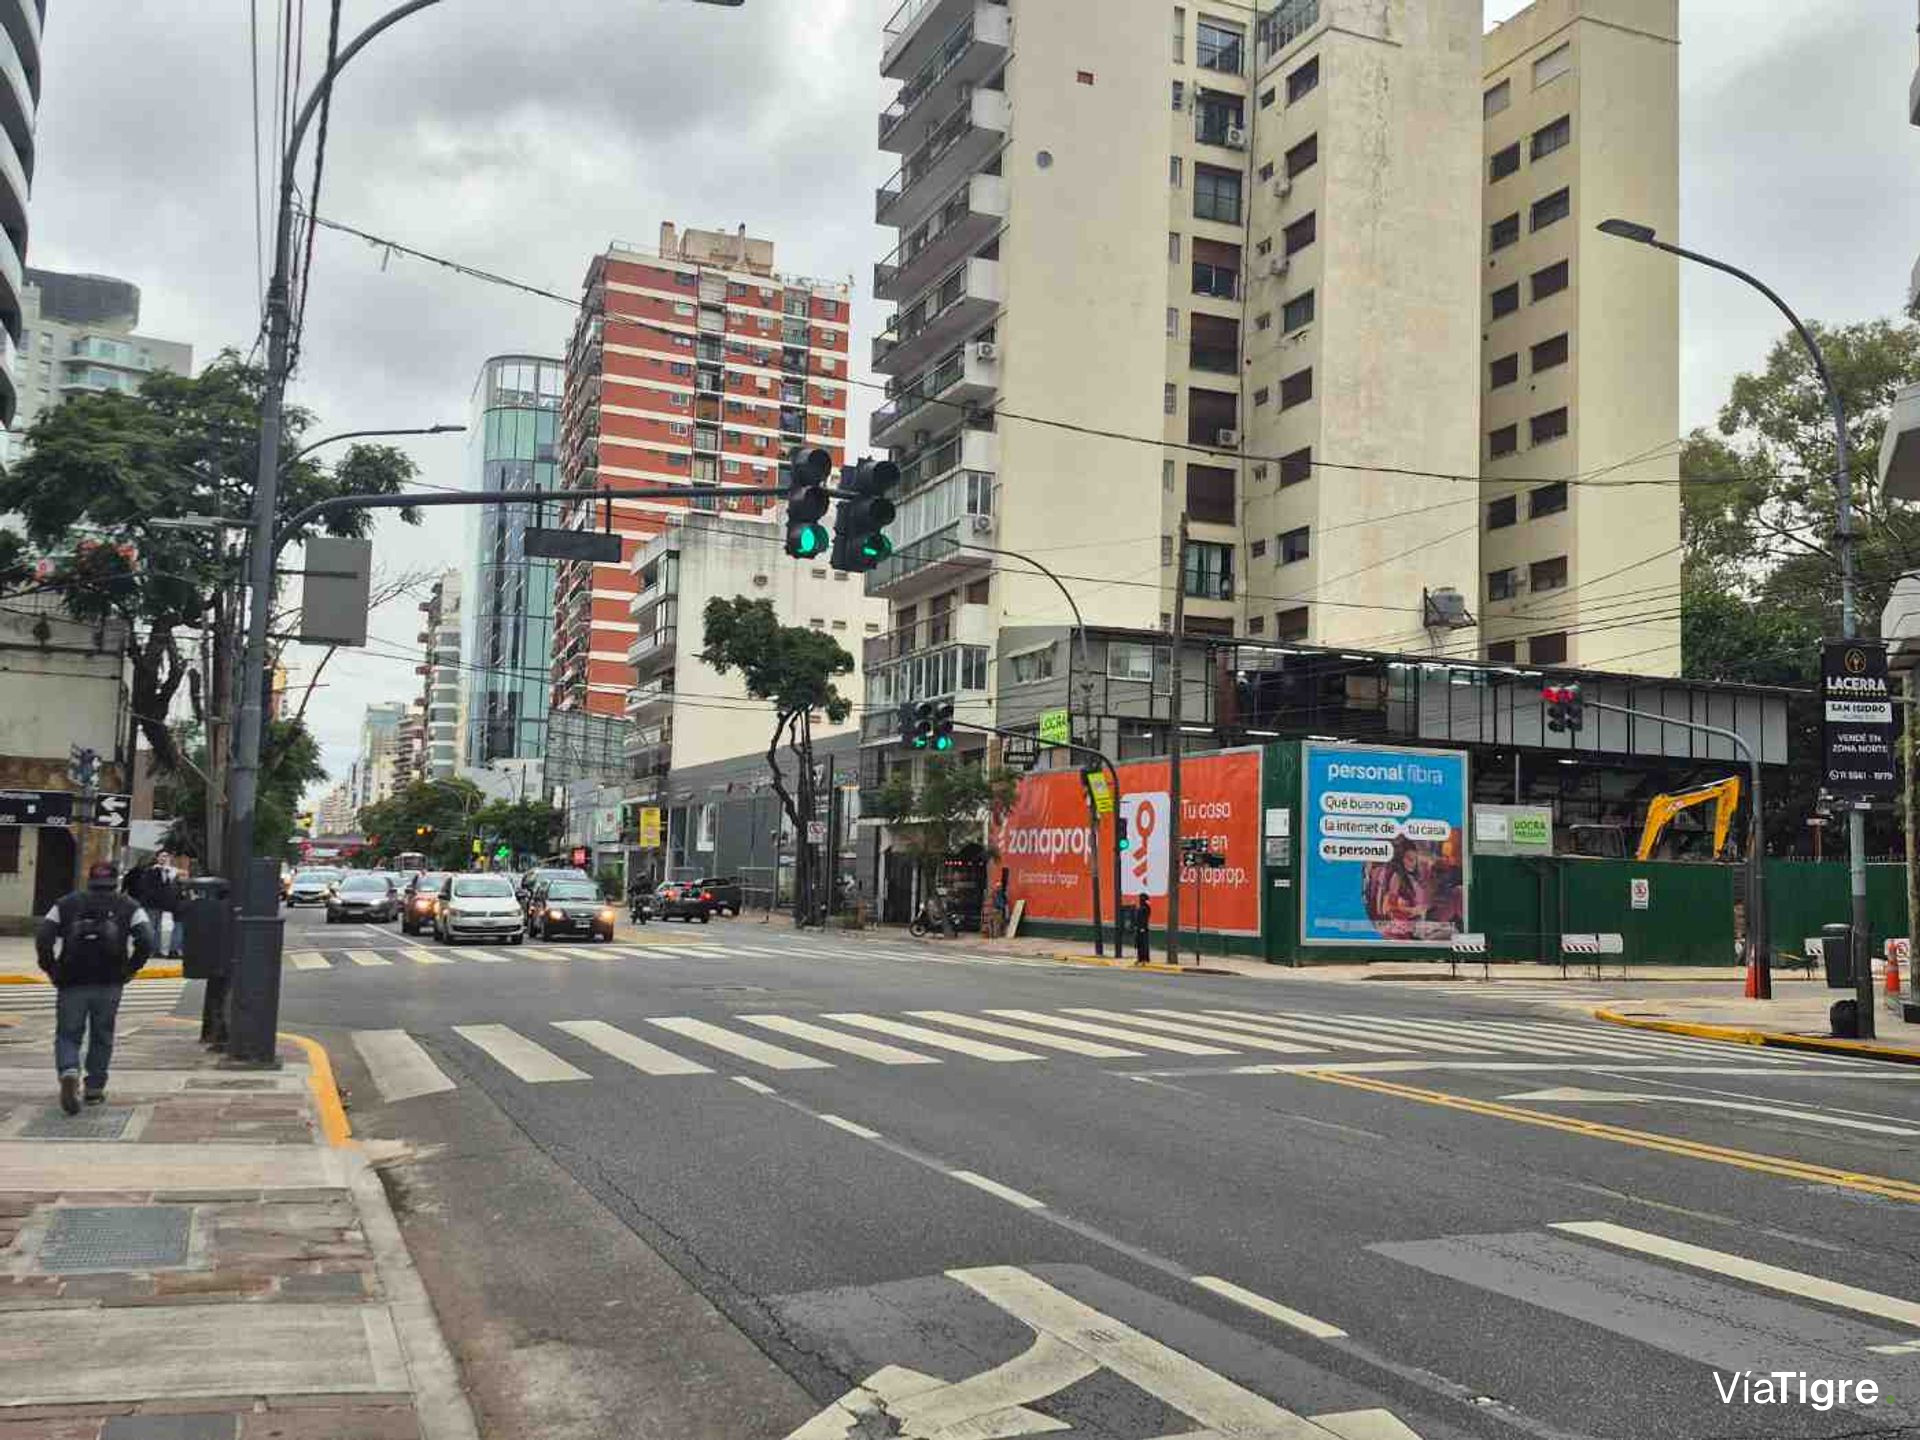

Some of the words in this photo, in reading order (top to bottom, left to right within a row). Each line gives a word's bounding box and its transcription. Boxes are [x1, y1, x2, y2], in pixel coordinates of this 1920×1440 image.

[1827, 676, 1887, 691] LACERRA
[1328, 763, 1403, 781] personal
[1180, 799, 1196, 819] Tu
[1199, 801, 1231, 820] casa
[1325, 796, 1348, 810] Qué
[1350, 798, 1384, 810] bueno
[1386, 801, 1407, 812] que
[1324, 819, 1335, 831] la
[1337, 819, 1379, 833] internet
[1382, 821, 1395, 834] de
[1408, 824, 1419, 835] tu
[1421, 825, 1446, 835] casa
[1210, 835, 1229, 850] en
[1323, 844, 1337, 855] es
[1339, 843, 1388, 857] personal
